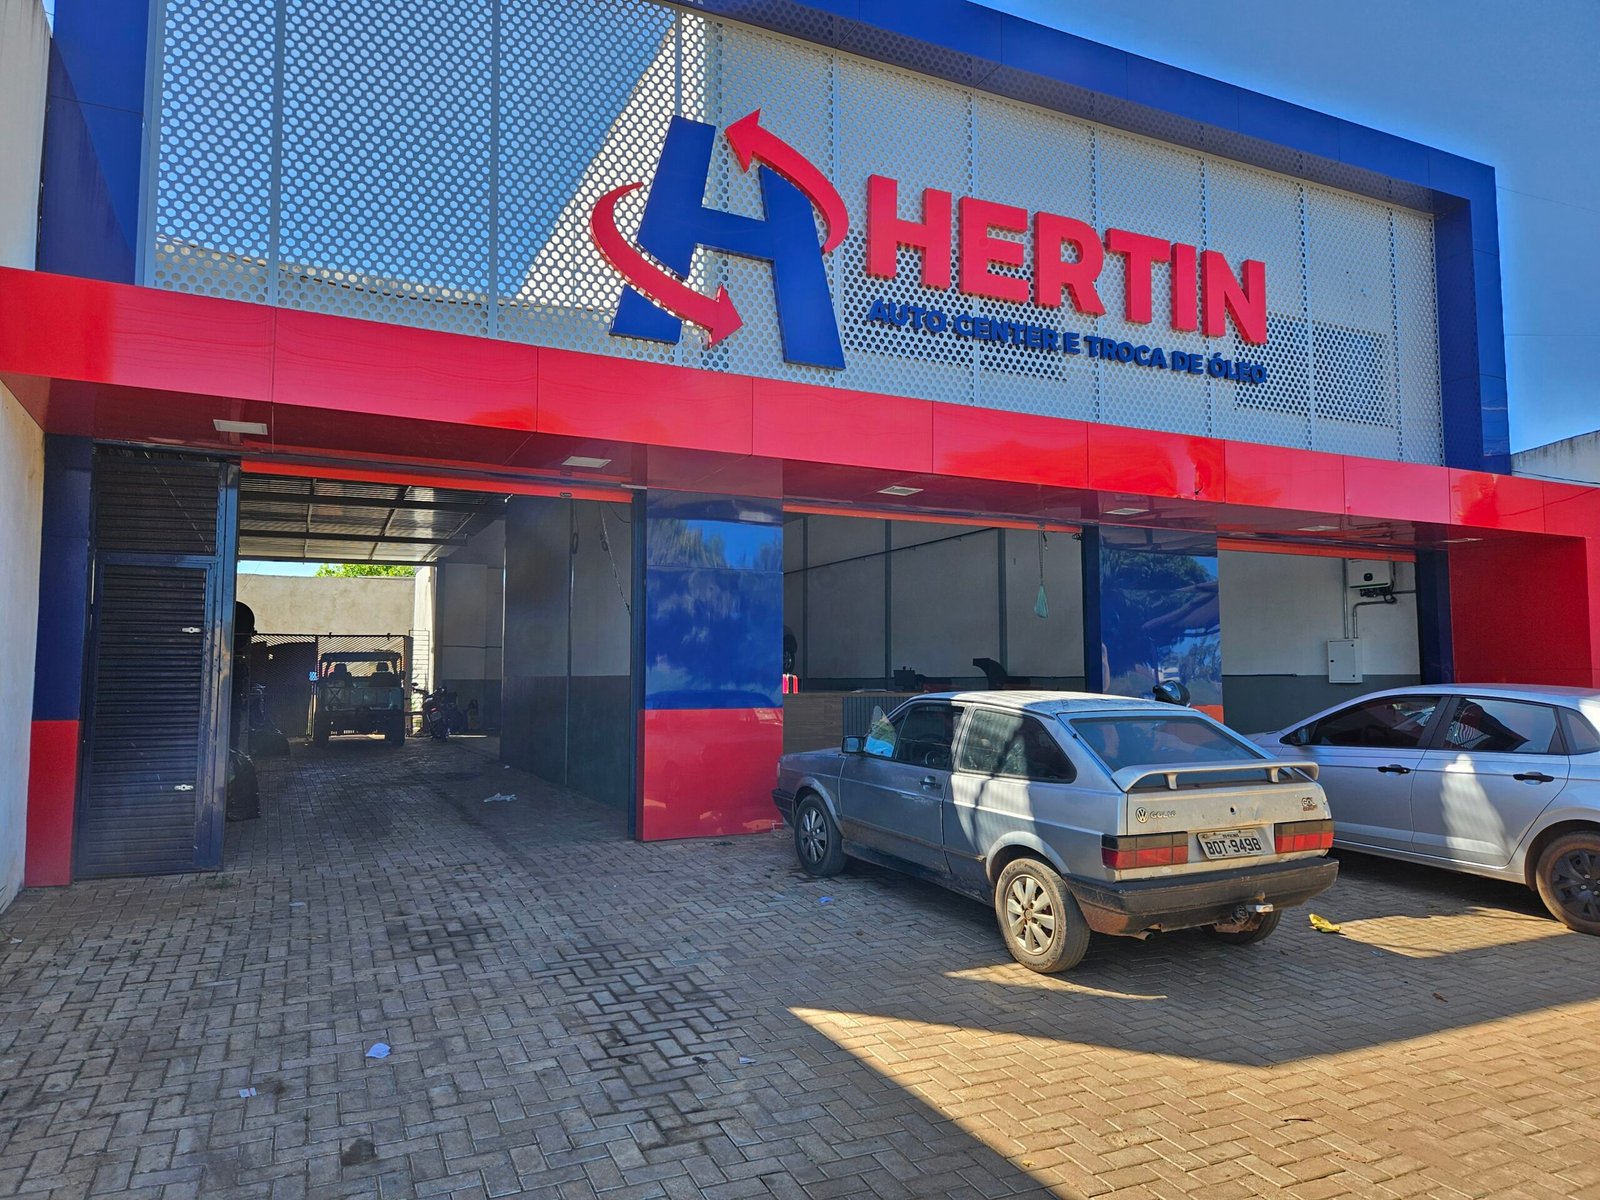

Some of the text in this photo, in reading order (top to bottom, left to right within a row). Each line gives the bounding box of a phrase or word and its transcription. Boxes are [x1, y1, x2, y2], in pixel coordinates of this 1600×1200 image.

[866, 173, 1268, 346] HERTIN
[867, 299, 1268, 384] AUTO CENTER E TROCA DE ÓLEO
